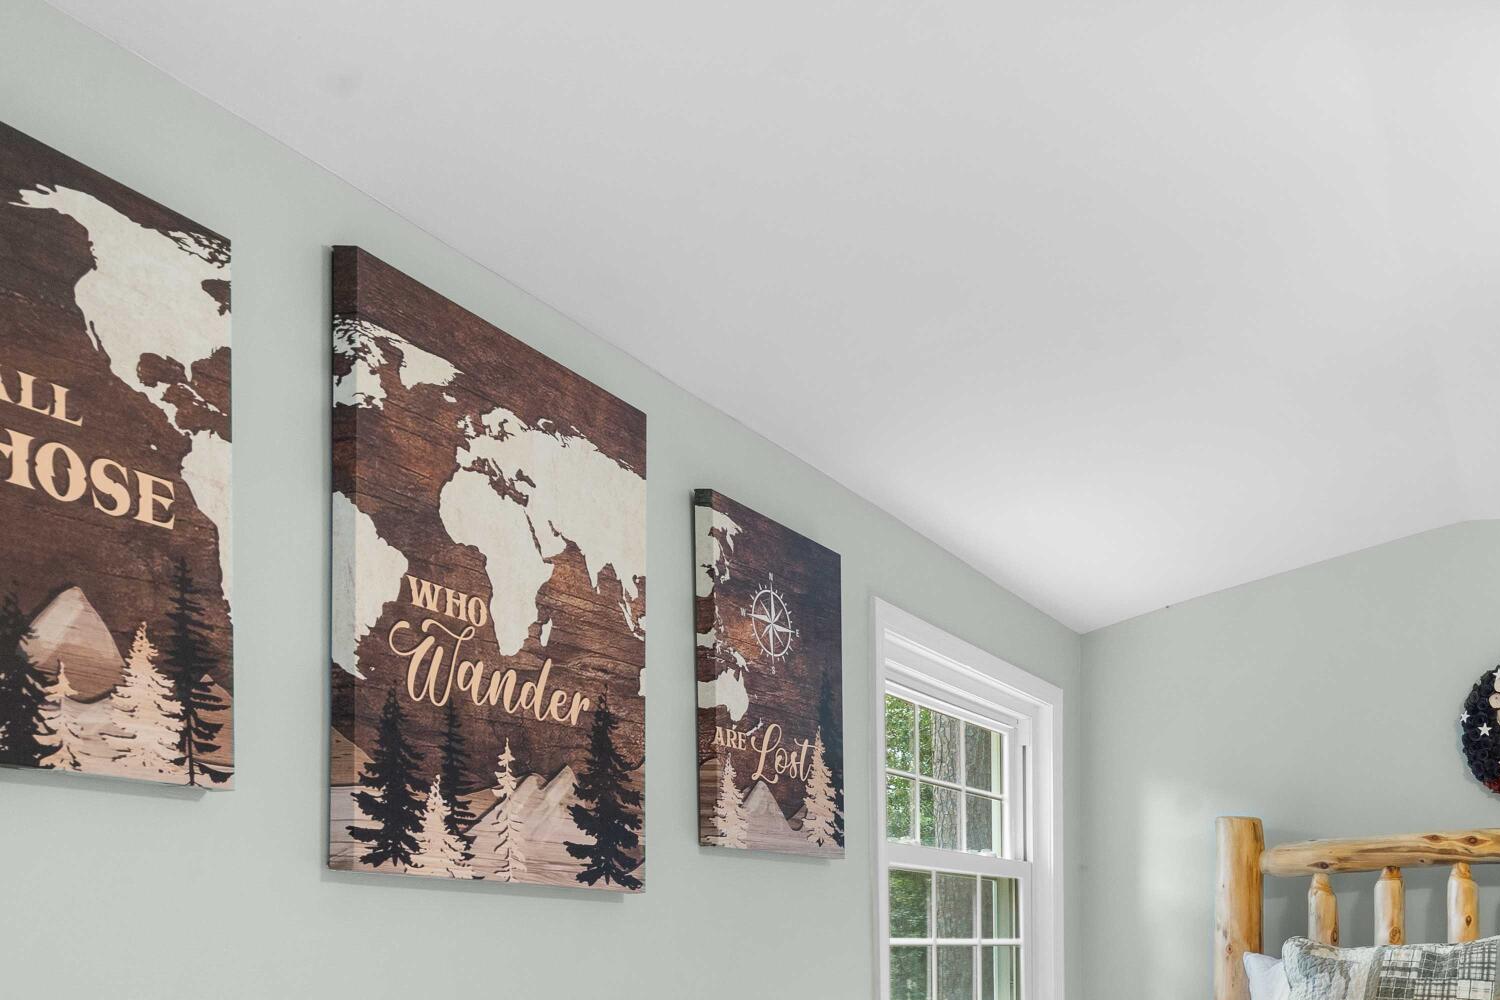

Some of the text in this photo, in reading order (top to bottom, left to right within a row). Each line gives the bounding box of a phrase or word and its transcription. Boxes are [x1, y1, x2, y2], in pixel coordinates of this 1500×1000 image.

[768, 572, 774, 581] N
[406, 575, 488, 628] WHO
[740, 607, 747, 617] W
[795, 629, 800, 638] E
[388, 618, 590, 726] Wander
[771, 666, 776, 675] S
[711, 723, 816, 784] ARE Lost
